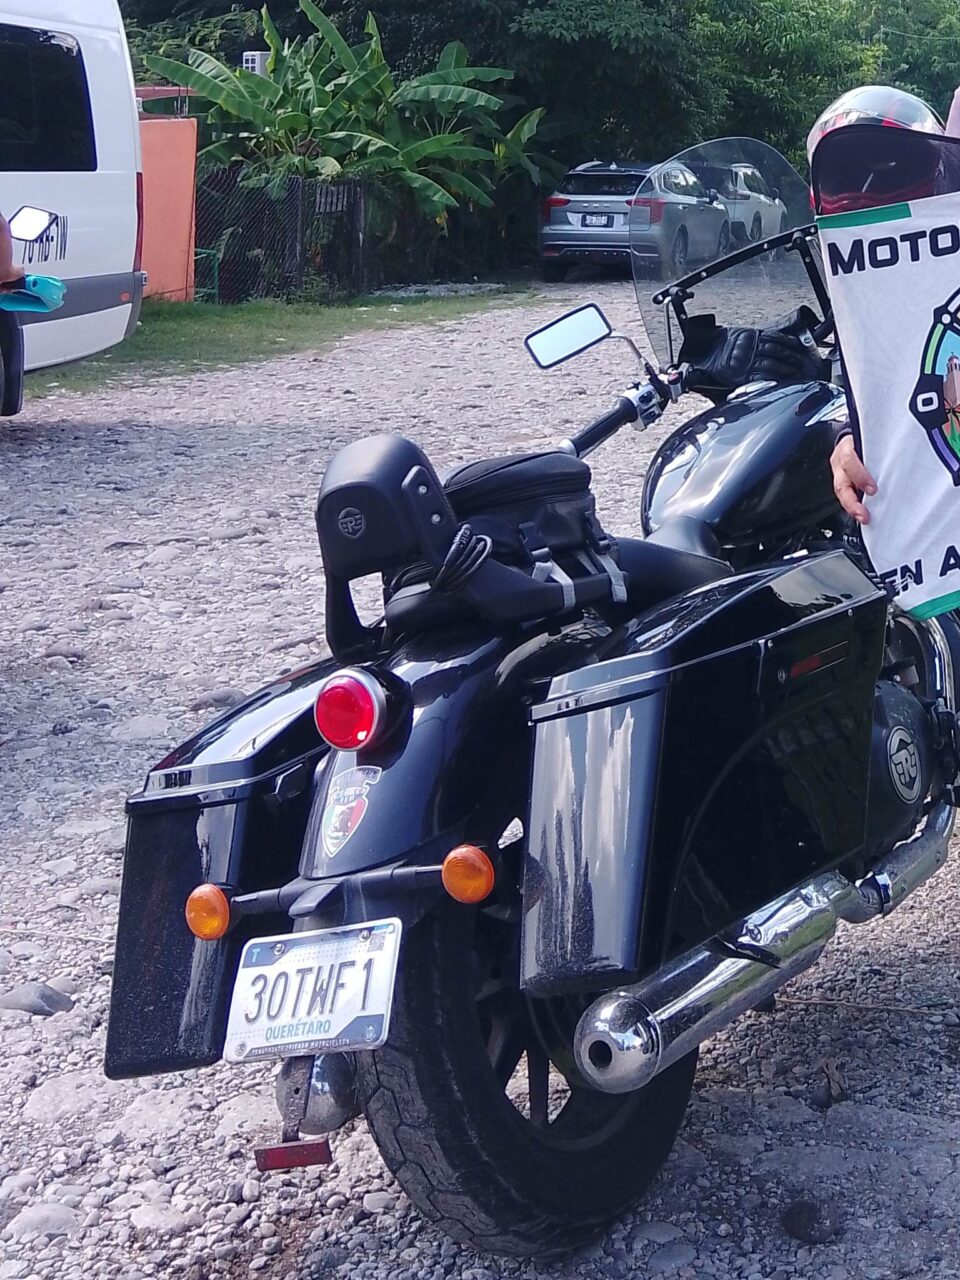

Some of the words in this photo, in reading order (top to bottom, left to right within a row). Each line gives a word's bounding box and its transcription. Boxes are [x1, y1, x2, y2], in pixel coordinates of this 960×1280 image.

[916, 392, 939, 413] O
[879, 559, 924, 596] EN
[244, 958, 373, 1023] 30TWF1
[265, 1018, 331, 1041] QUERÉTARO
